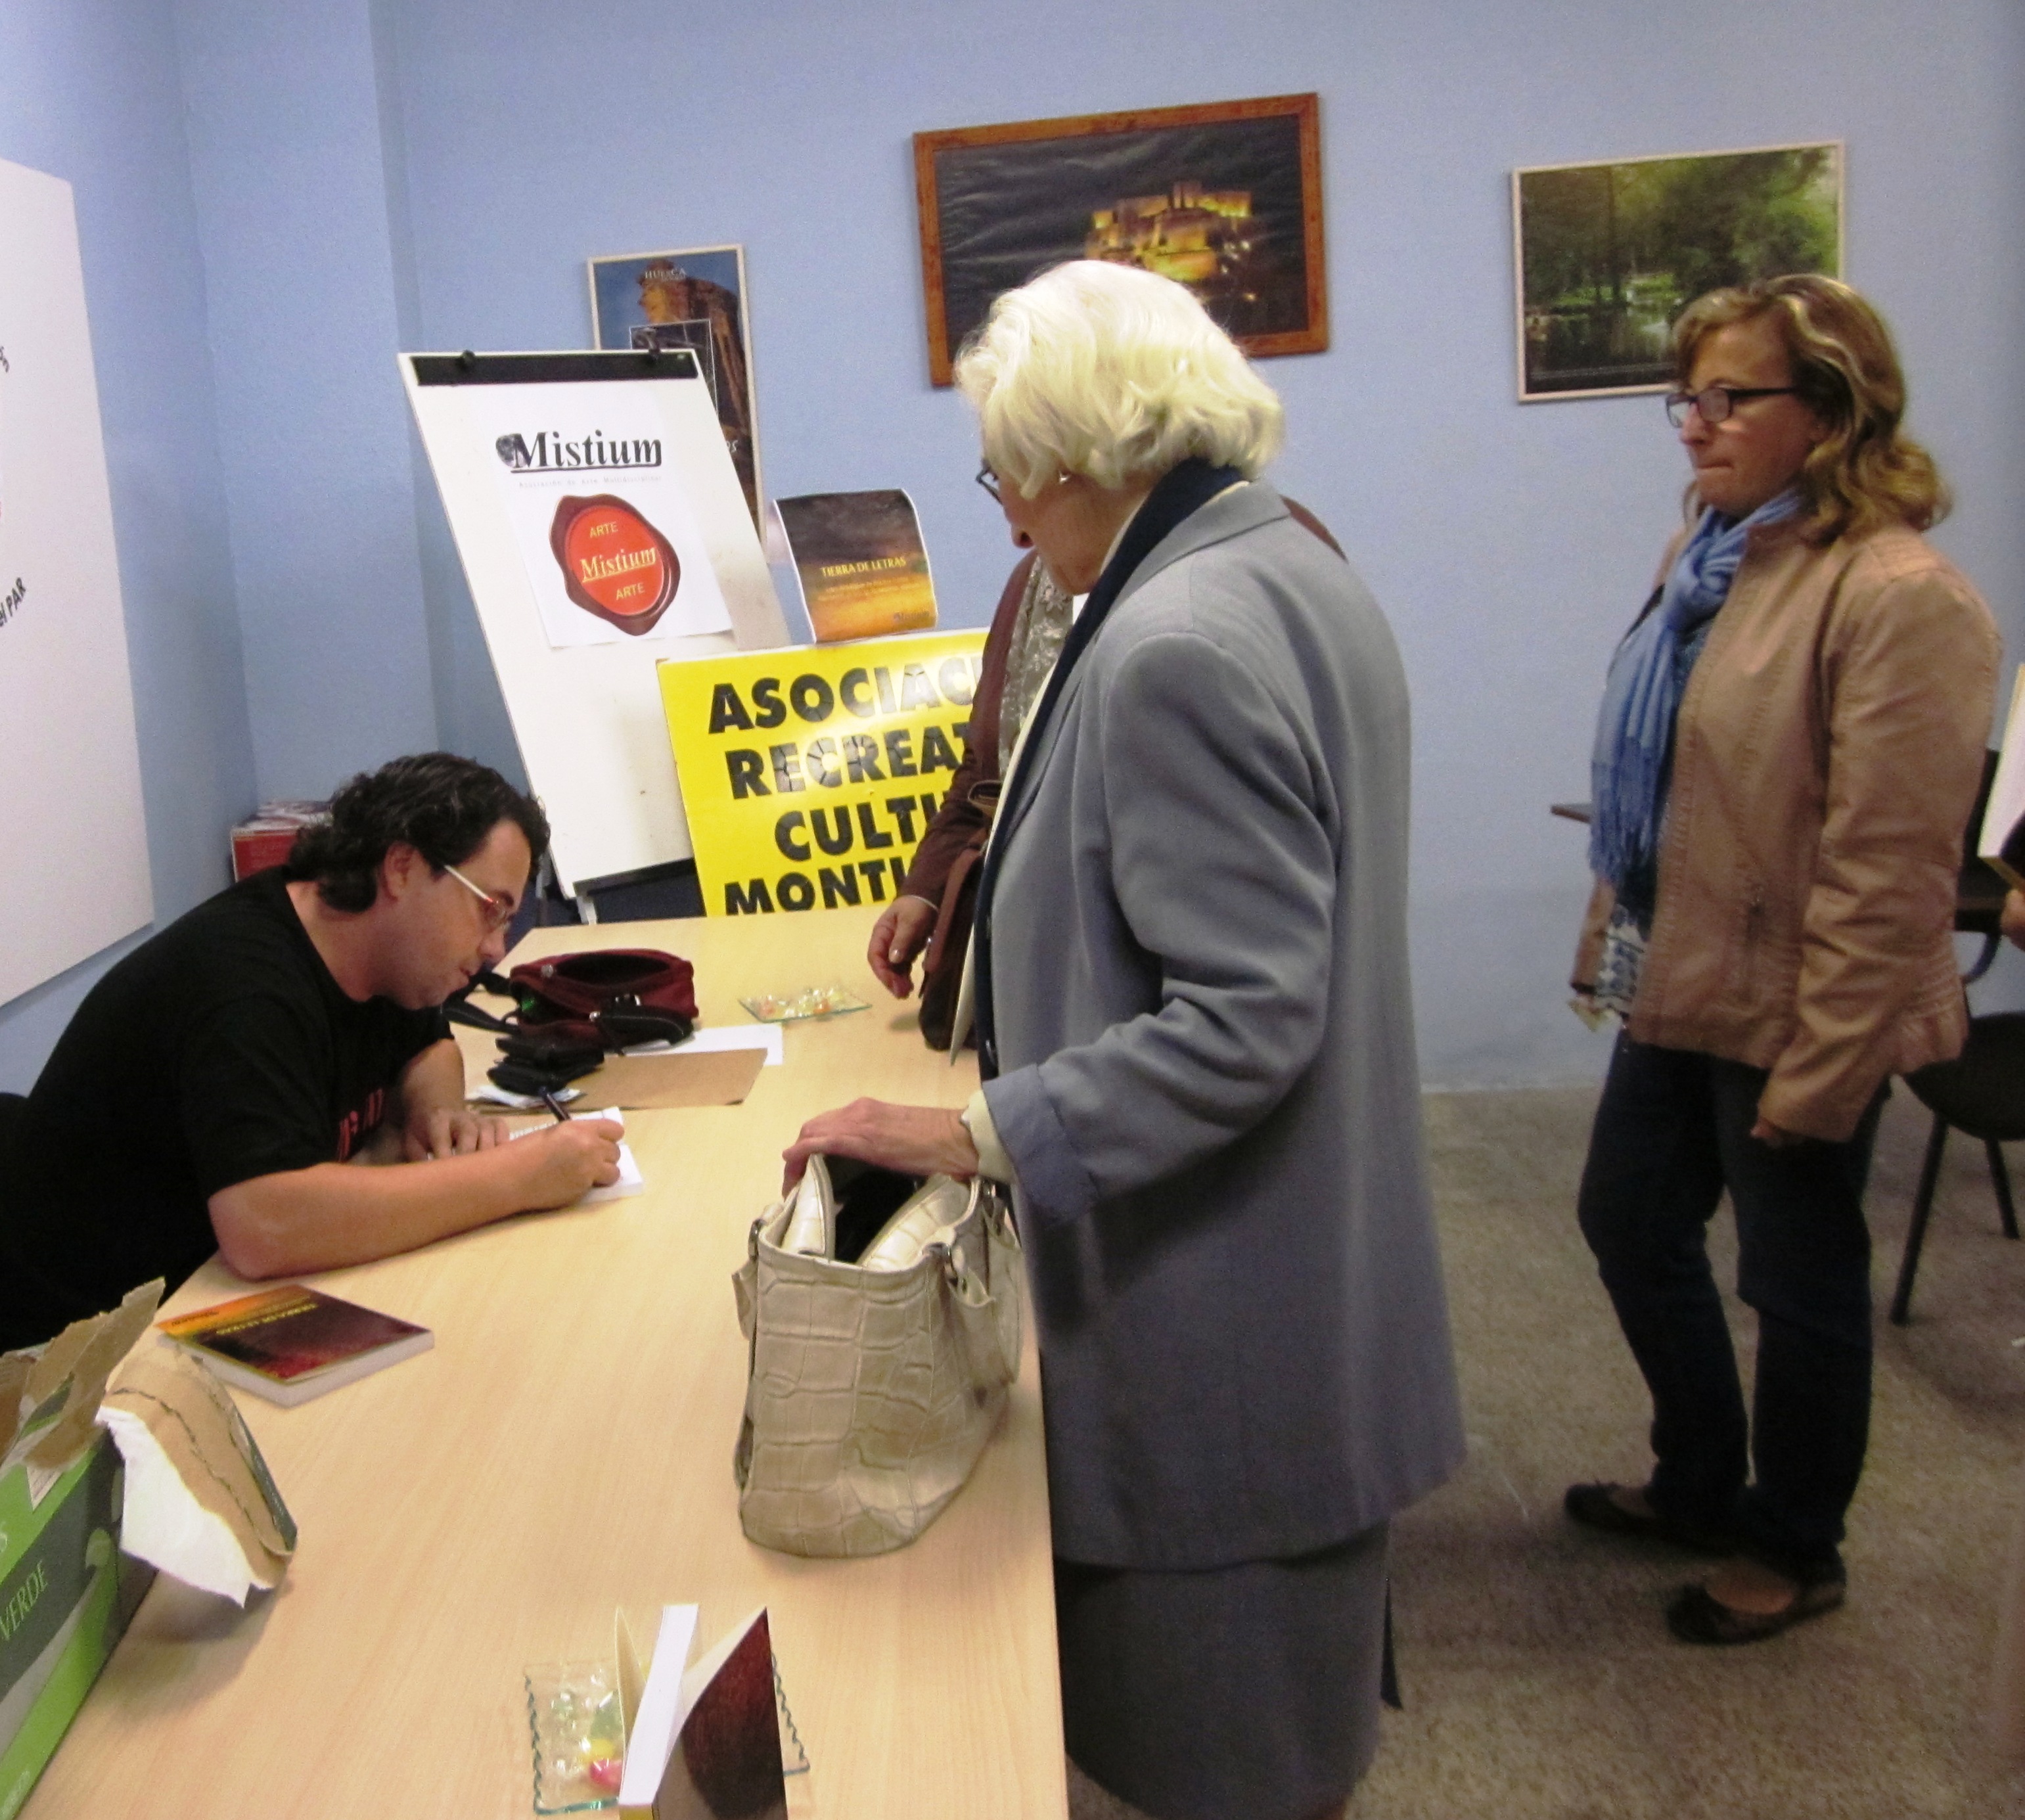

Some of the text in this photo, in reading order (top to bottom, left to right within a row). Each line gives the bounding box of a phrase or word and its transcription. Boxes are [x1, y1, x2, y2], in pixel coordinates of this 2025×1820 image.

[510, 429, 662, 470] Mistium
[590, 521, 618, 538] ARTE
[580, 547, 656, 583] Mistium
[821, 557, 906, 578] TIERRA DE LETRAS
[6, 578, 26, 617] PAR
[616, 583, 645, 601] ARTE
[0, 1558, 48, 1639] VERDE
